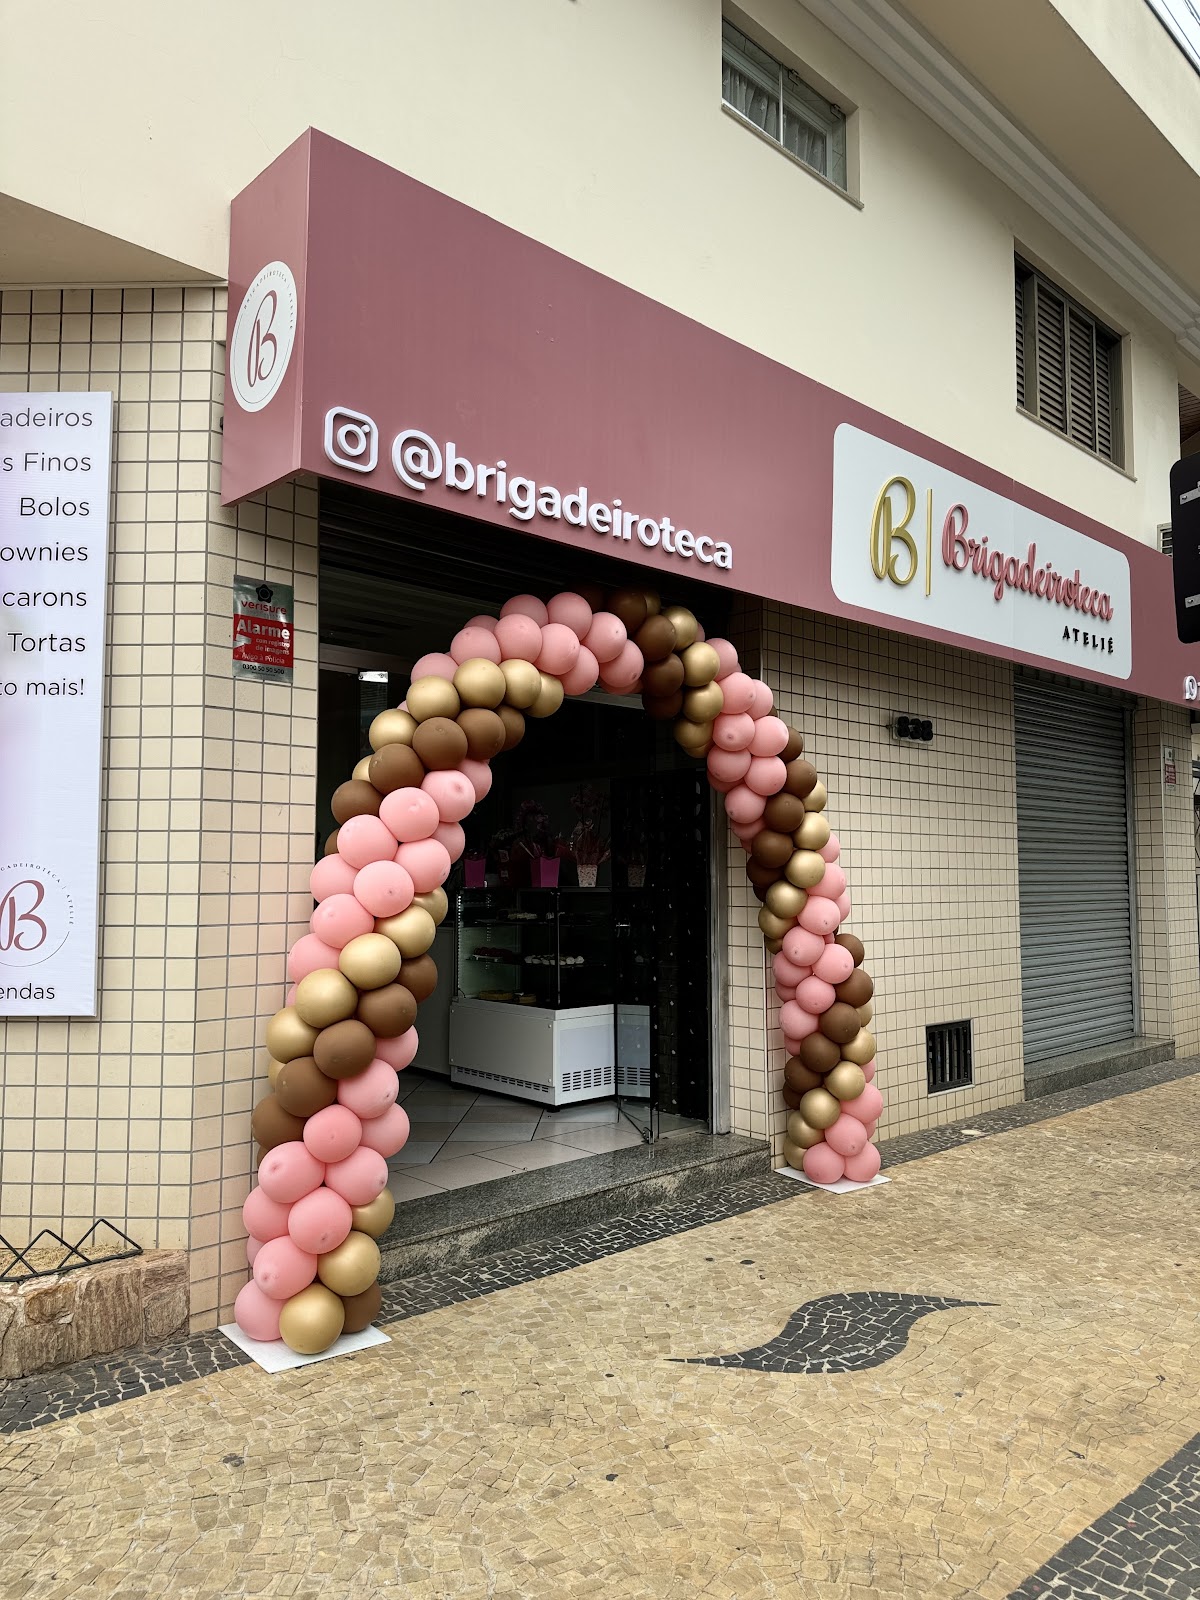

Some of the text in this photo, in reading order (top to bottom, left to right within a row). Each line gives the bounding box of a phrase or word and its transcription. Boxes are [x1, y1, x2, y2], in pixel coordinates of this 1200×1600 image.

[0, 408, 93, 427] adeiros
[24, 453, 91, 472] Finos
[20, 497, 90, 517] Bolos
[392, 428, 733, 570] @brigadeiroteca
[0, 542, 88, 562] ownies
[941, 503, 1115, 622] Brigadeiroteca
[2, 591, 87, 607] carons
[241, 600, 287, 614] verisure
[237, 619, 290, 640] Alarme
[1062, 625, 1114, 654] ATELIÉ
[8, 633, 86, 653] Tortas
[26, 677, 84, 696] mais!
